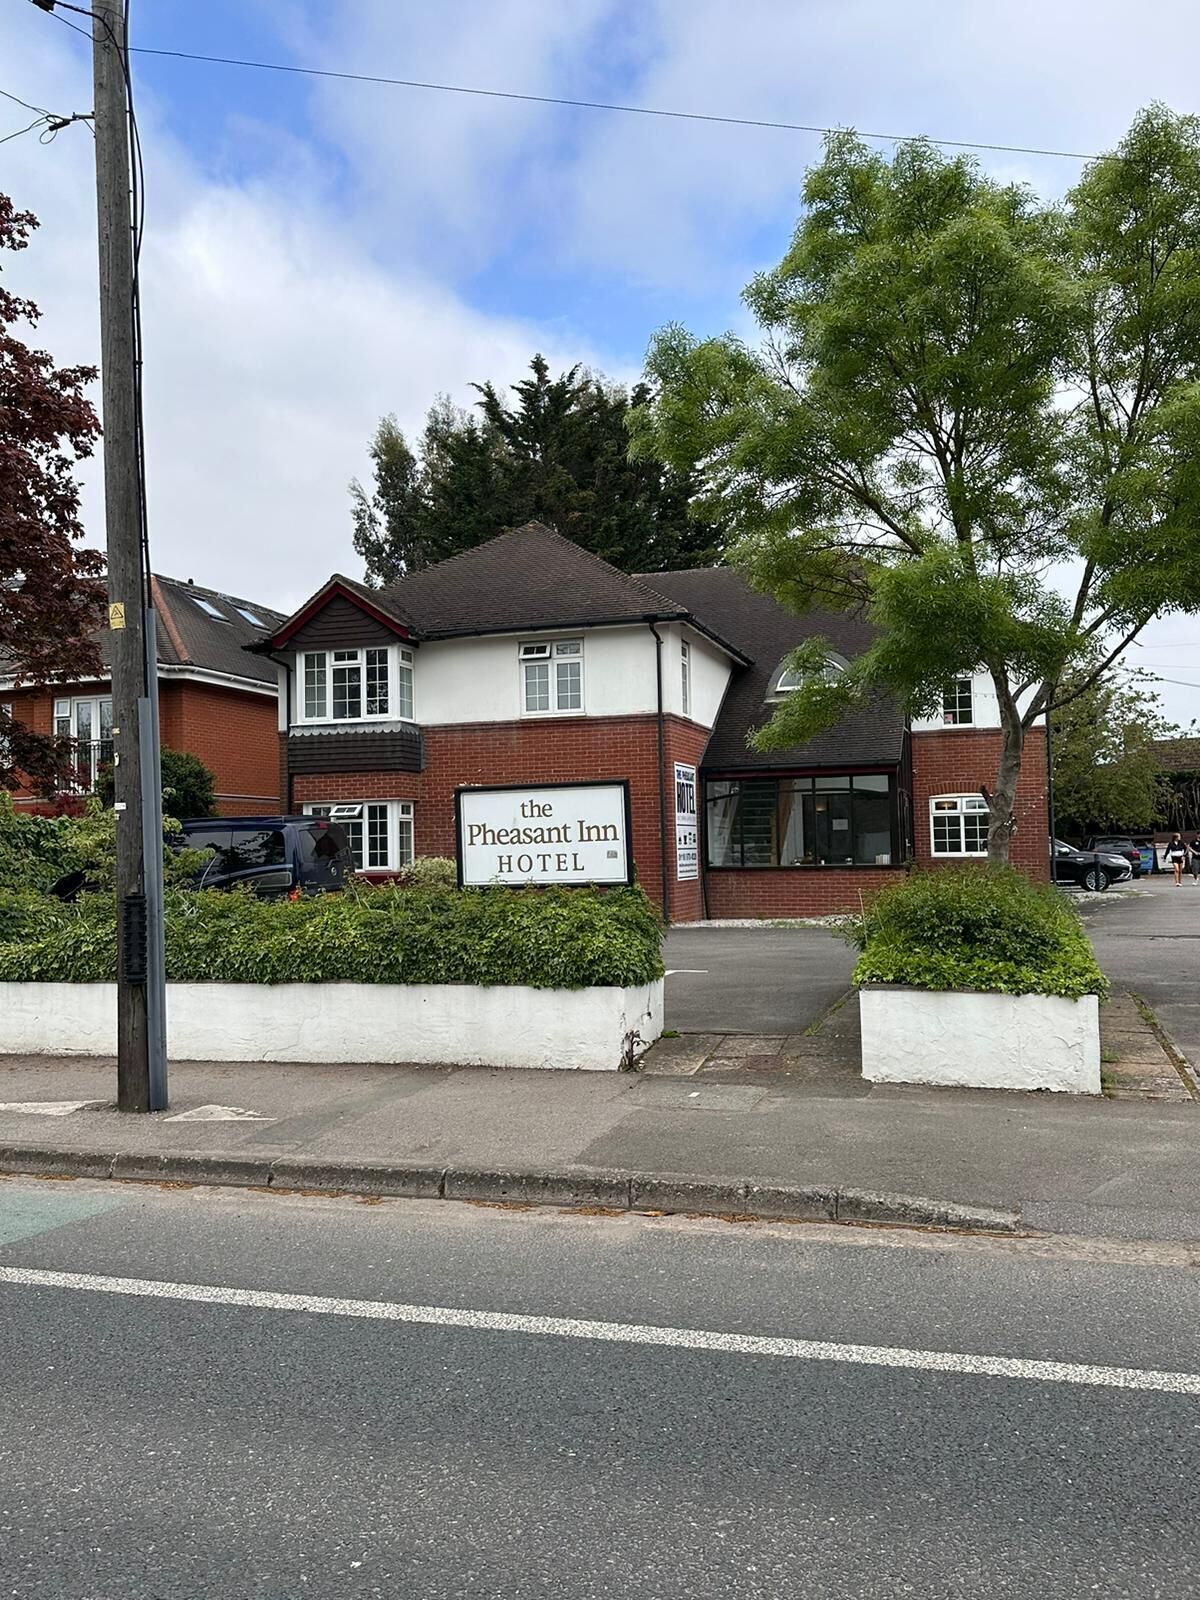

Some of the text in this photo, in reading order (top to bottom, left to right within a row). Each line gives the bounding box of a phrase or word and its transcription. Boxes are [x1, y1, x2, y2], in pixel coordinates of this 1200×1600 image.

[520, 799, 553, 818] the
[676, 781, 695, 814] HOTEL
[467, 820, 620, 846] Pheasant Inn
[497, 852, 585, 873] HOTEL
